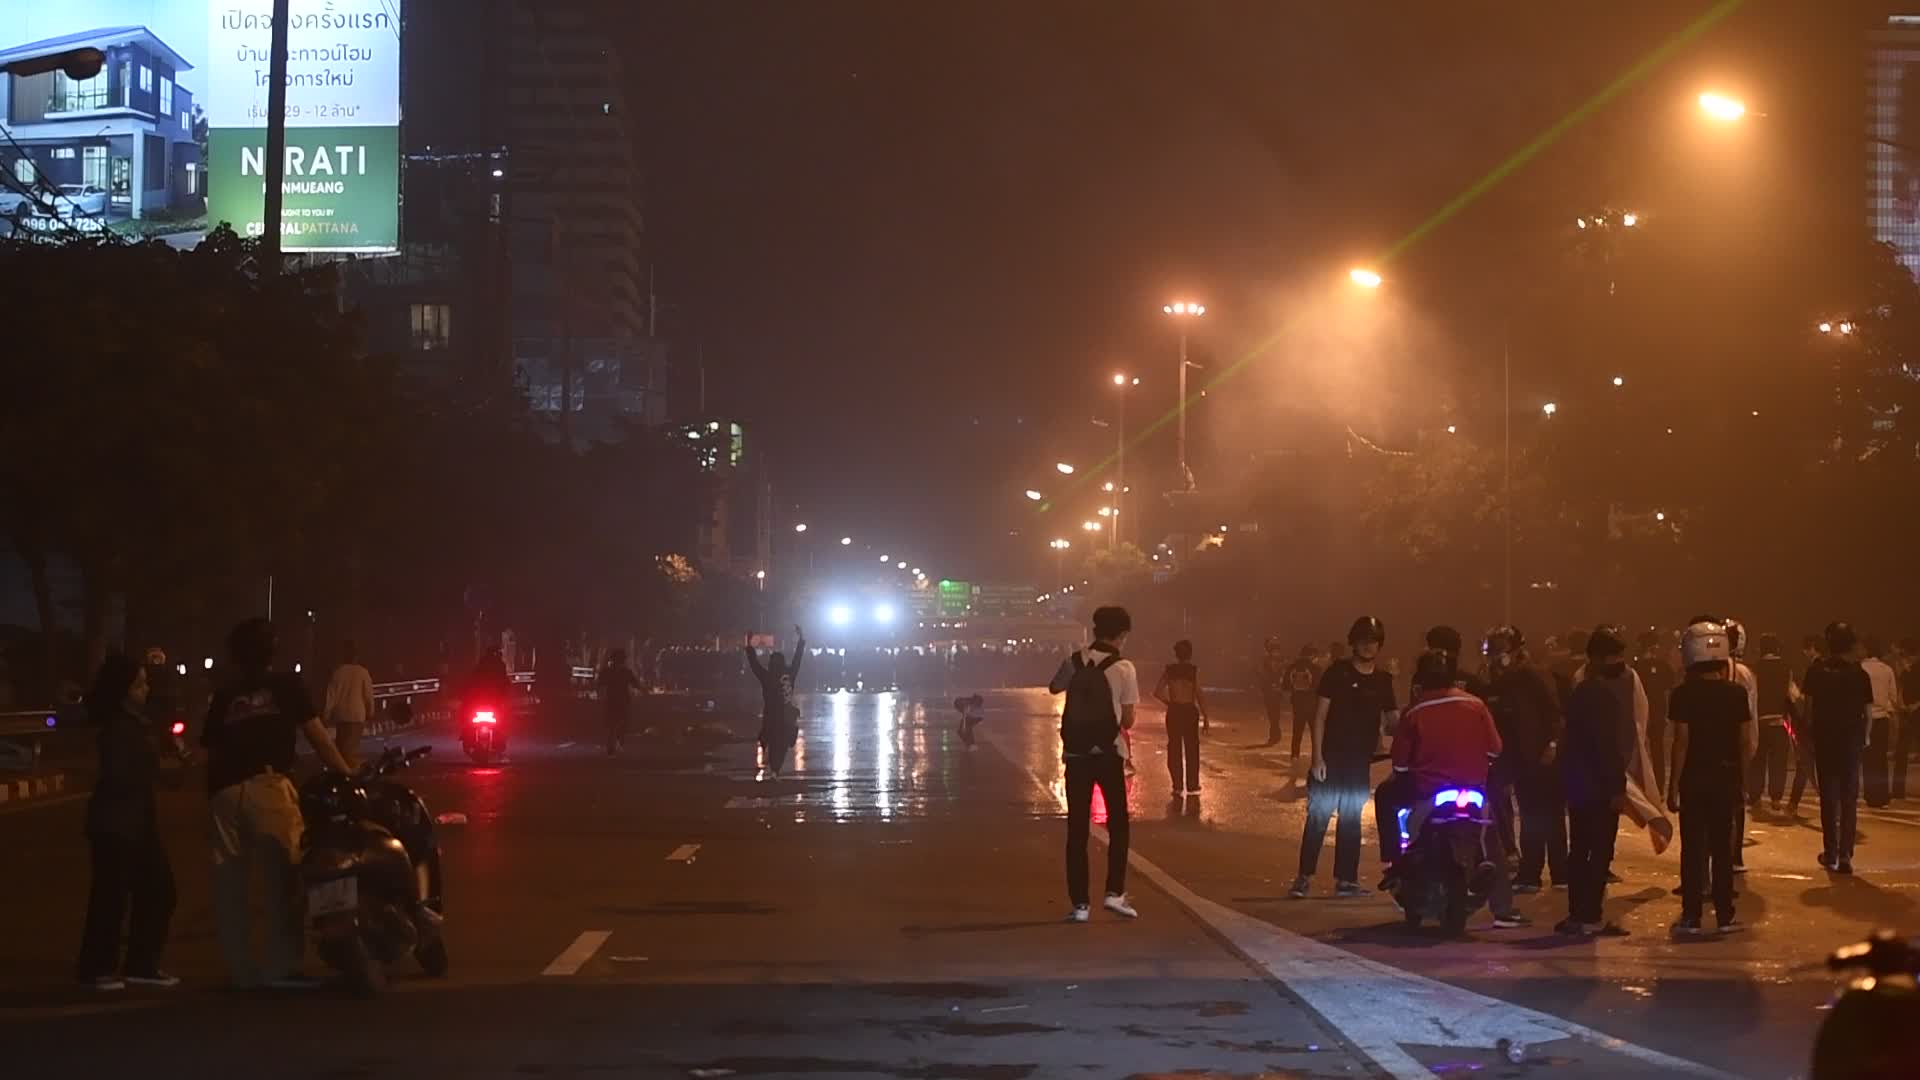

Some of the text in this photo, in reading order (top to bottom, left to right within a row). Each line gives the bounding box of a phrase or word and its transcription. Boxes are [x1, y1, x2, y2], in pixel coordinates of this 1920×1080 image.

[221, 1, 388, 30] เปิดจงครั้งแรก
[255, 68, 353, 87] โคงการใหม่
[315, 105, 327, 117] 12
[241, 145, 366, 176] NRATI
[262, 181, 344, 194] NMUEANG
[246, 222, 359, 236] CERALPATTANA
